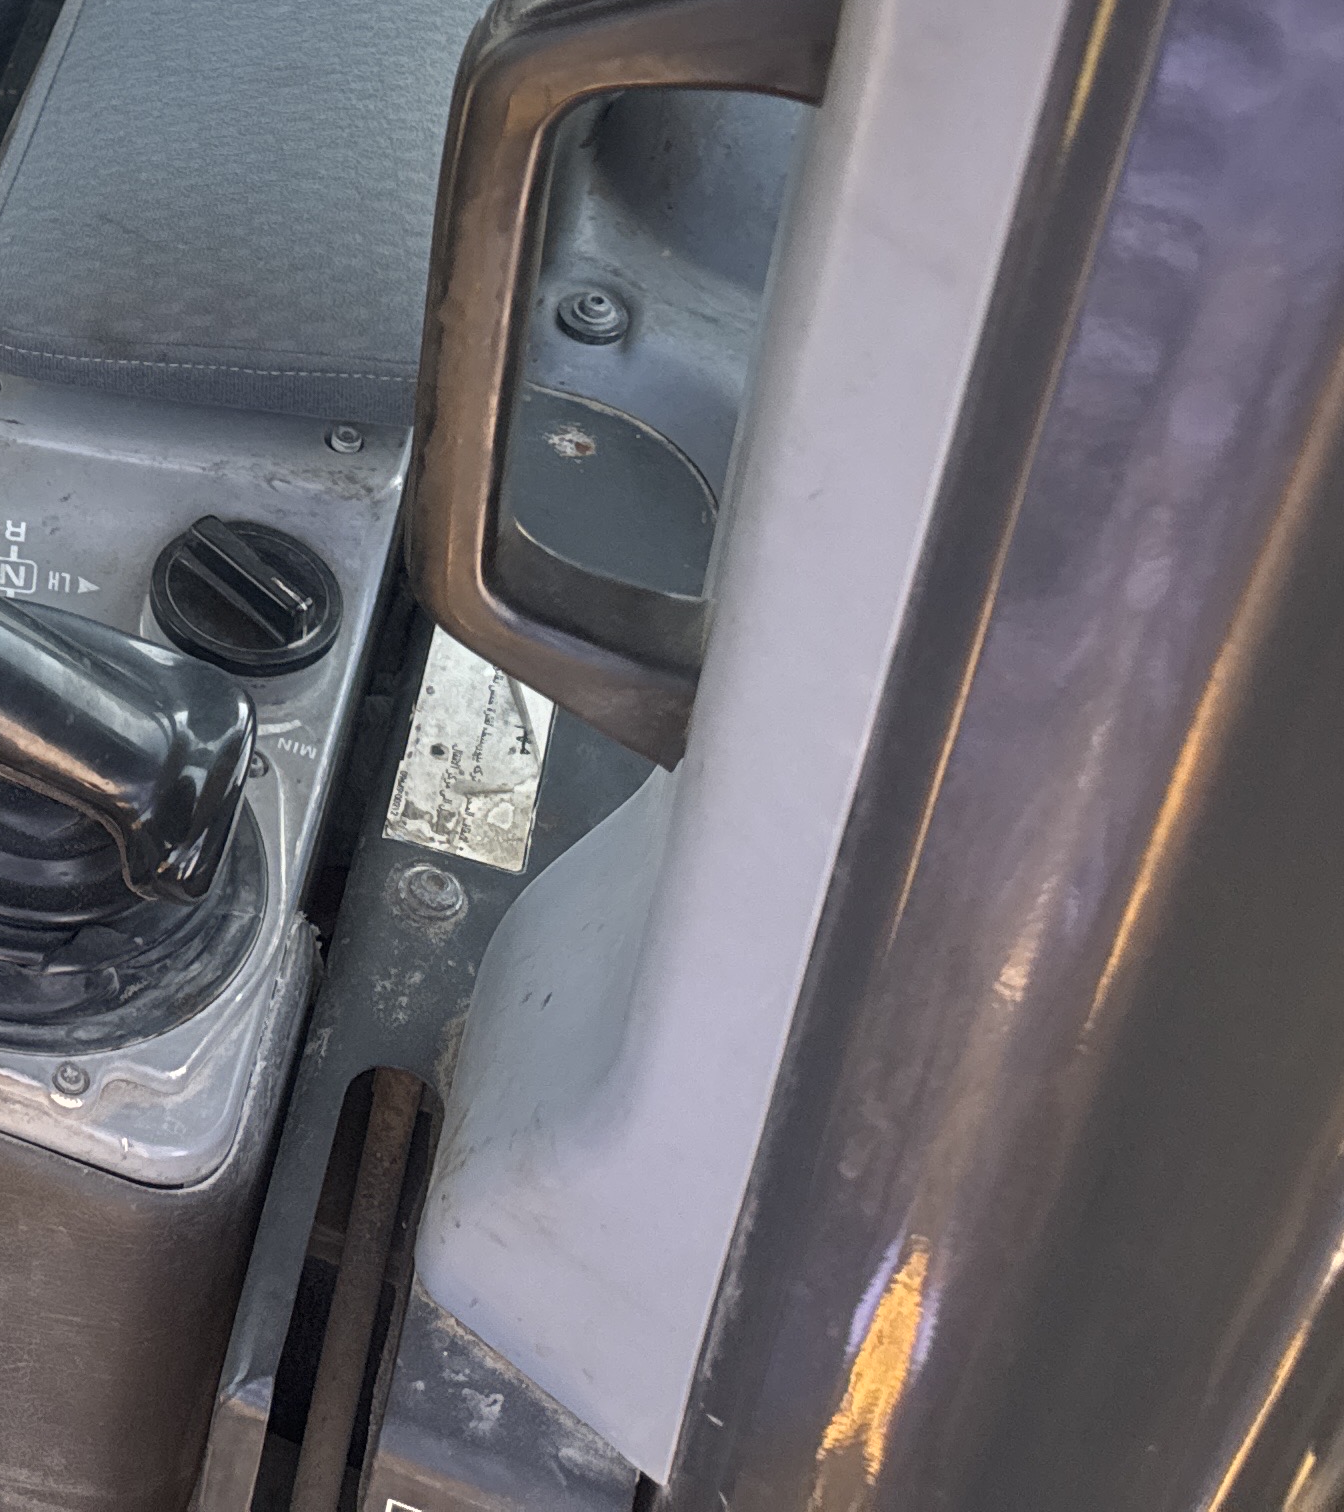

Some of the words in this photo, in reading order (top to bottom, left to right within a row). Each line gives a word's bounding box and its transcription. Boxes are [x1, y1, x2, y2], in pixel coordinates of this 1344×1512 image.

[5, 520, 26, 542] R
[0, 563, 26, 587] N
[48, 570, 71, 593] LH
[277, 738, 317, 759] MIN
